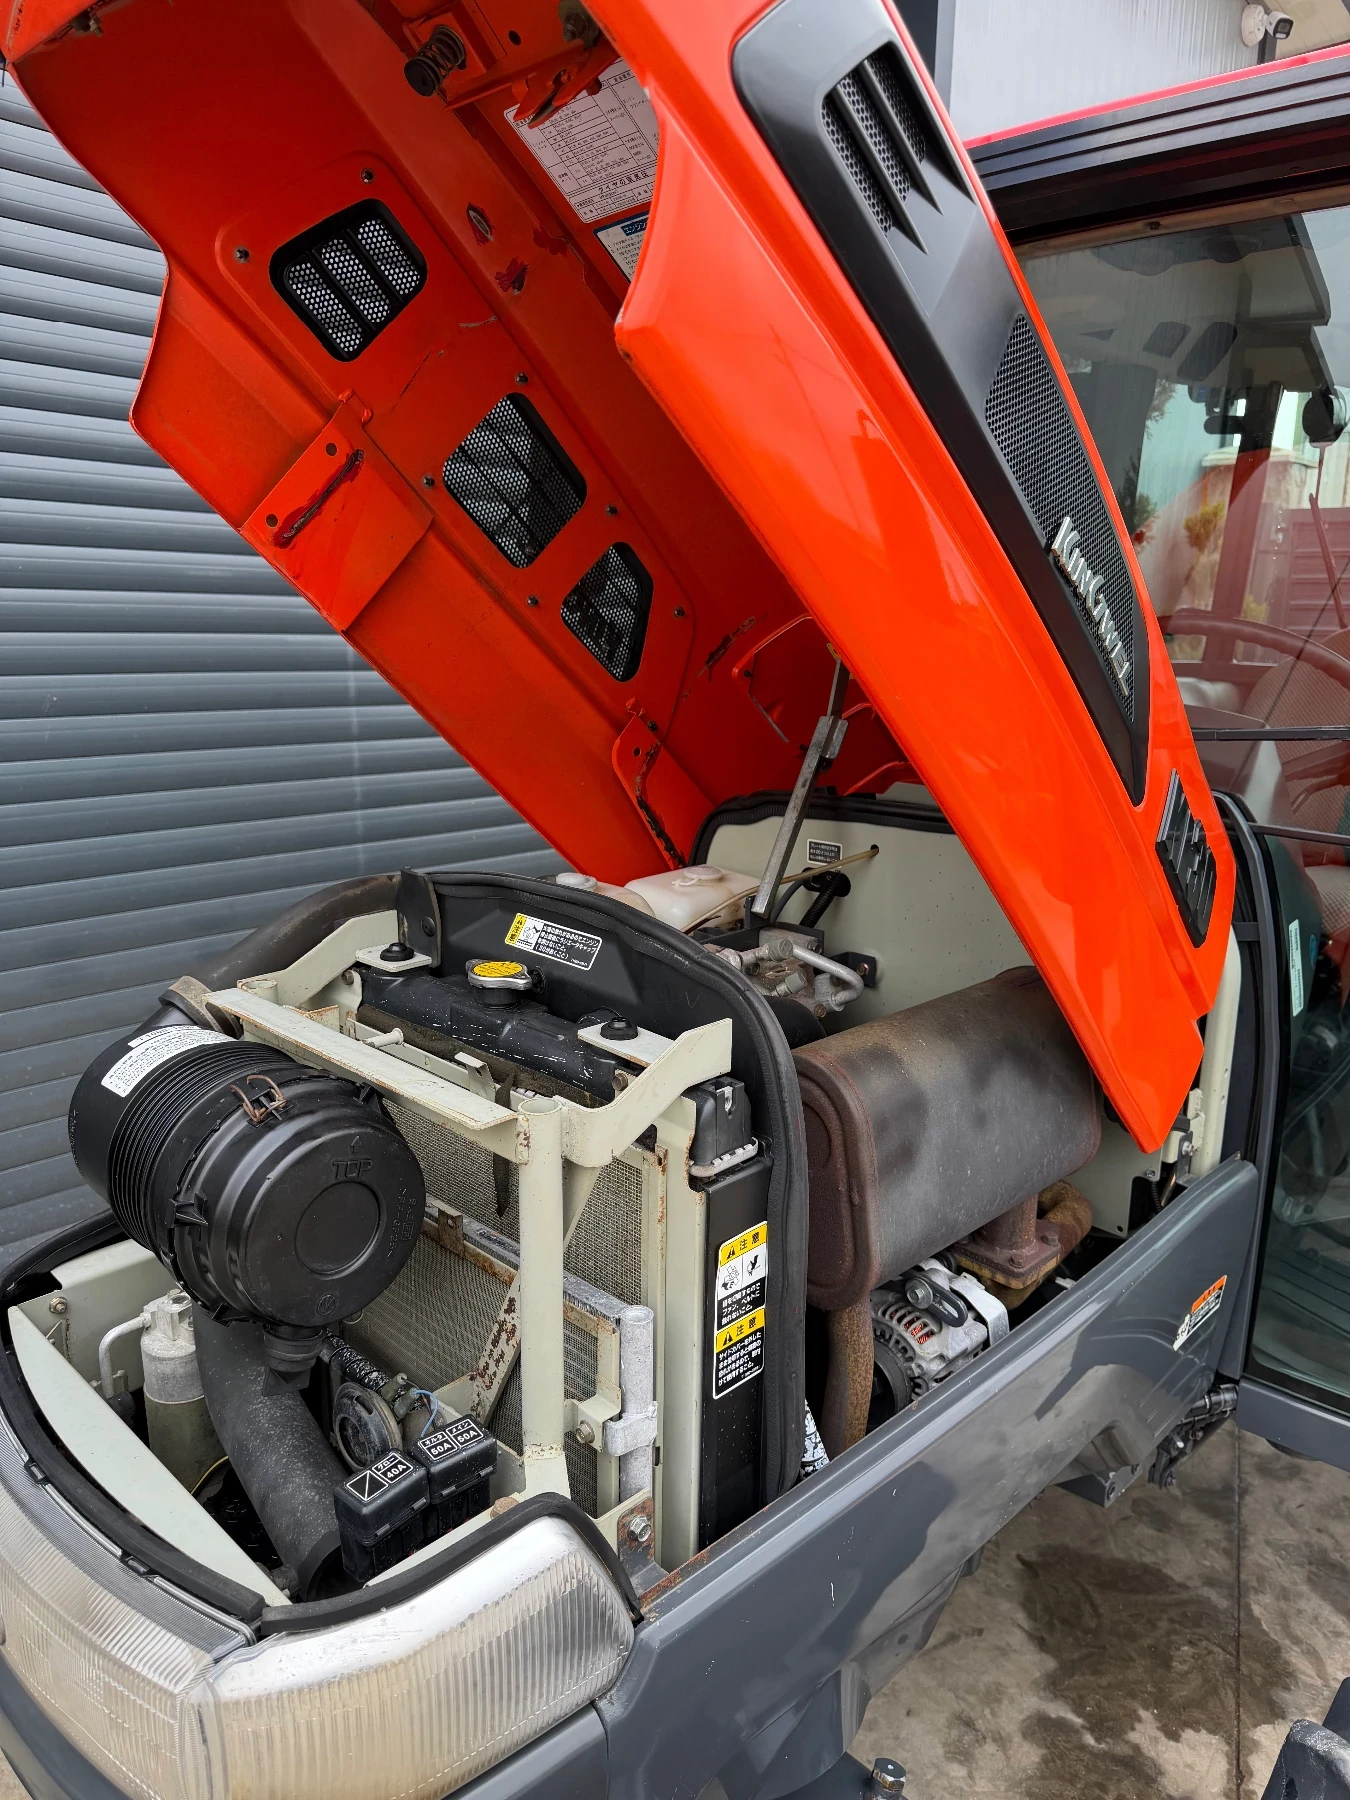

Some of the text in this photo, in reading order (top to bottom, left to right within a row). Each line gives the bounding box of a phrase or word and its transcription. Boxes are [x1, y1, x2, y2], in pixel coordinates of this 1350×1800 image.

[332, 1159, 374, 1180] TOP
[739, 1231, 760, 1250] 注意
[736, 1316, 757, 1337] 注意
[451, 1422, 471, 1434] メイン
[424, 1434, 444, 1446] オルタ
[456, 1431, 478, 1443] 50A
[430, 1443, 453, 1456] 50A
[377, 1455, 396, 1469] グロー
[386, 1464, 407, 1479] 40A
